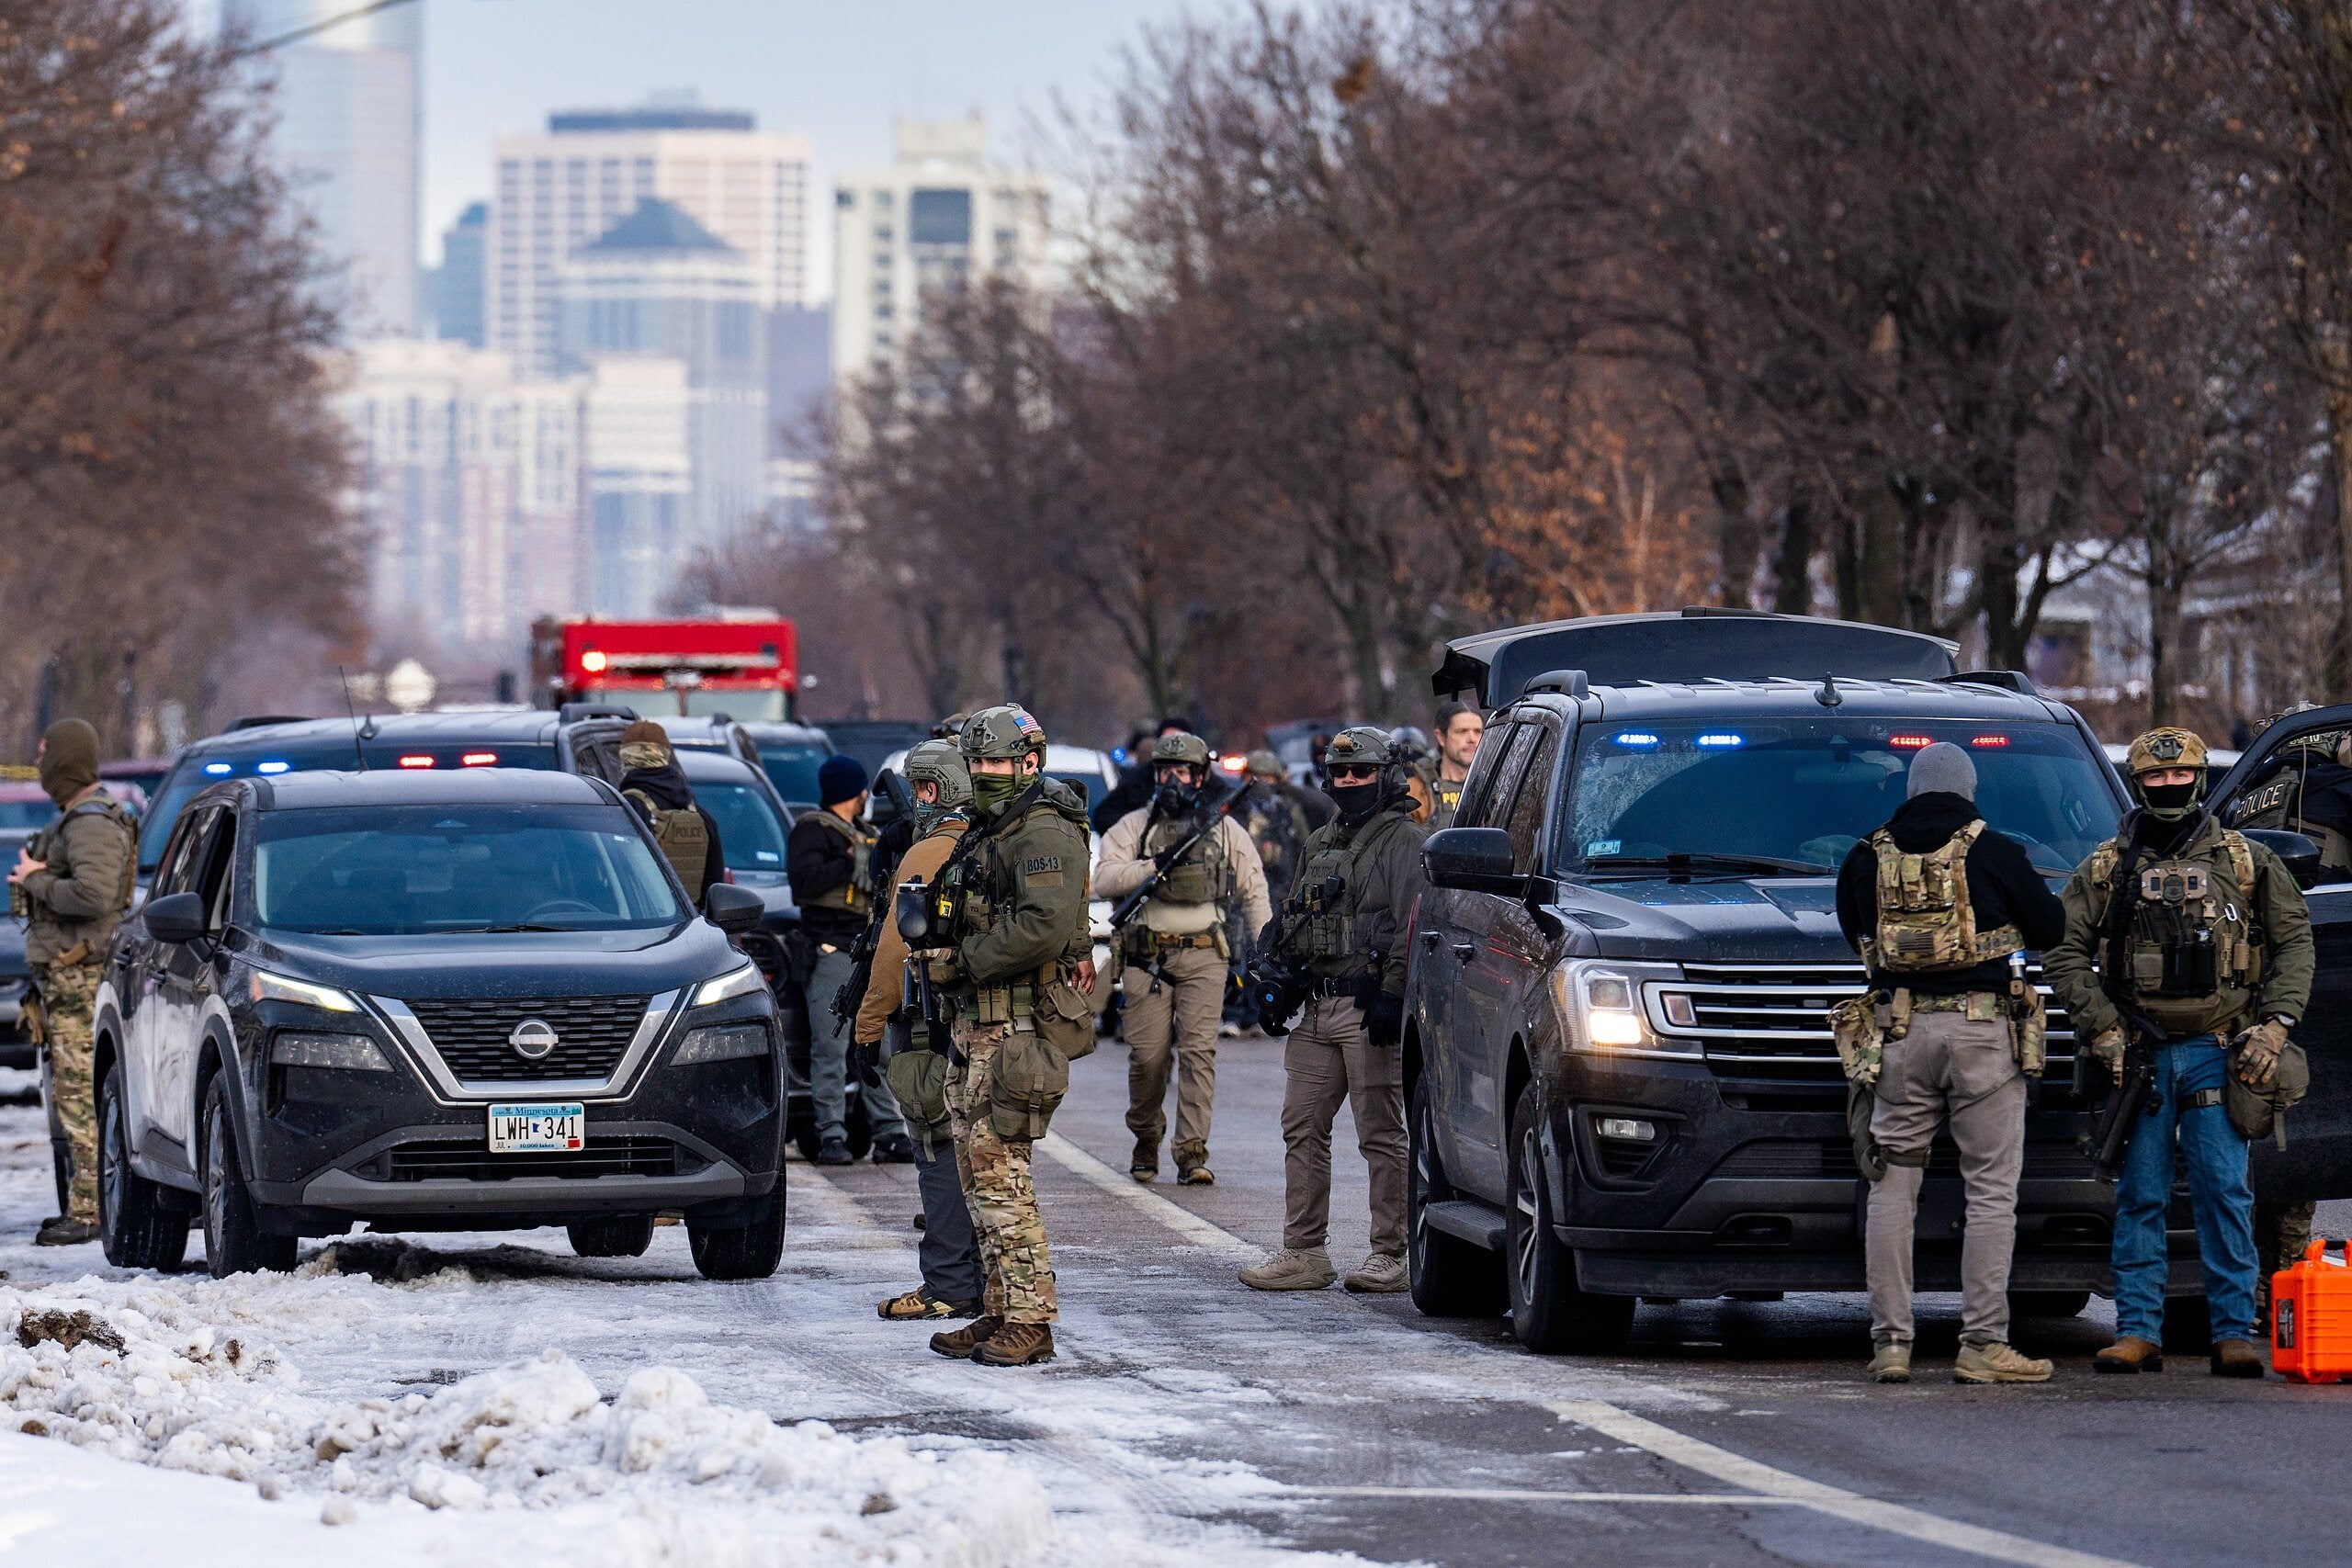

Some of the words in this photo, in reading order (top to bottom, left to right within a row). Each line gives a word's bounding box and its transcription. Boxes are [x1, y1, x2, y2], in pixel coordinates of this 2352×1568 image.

[2233, 784, 2285, 823] POLICE
[1027, 857, 1058, 872] BOS-13
[495, 1116, 529, 1140] LWH
[544, 1116, 578, 1139] 341
